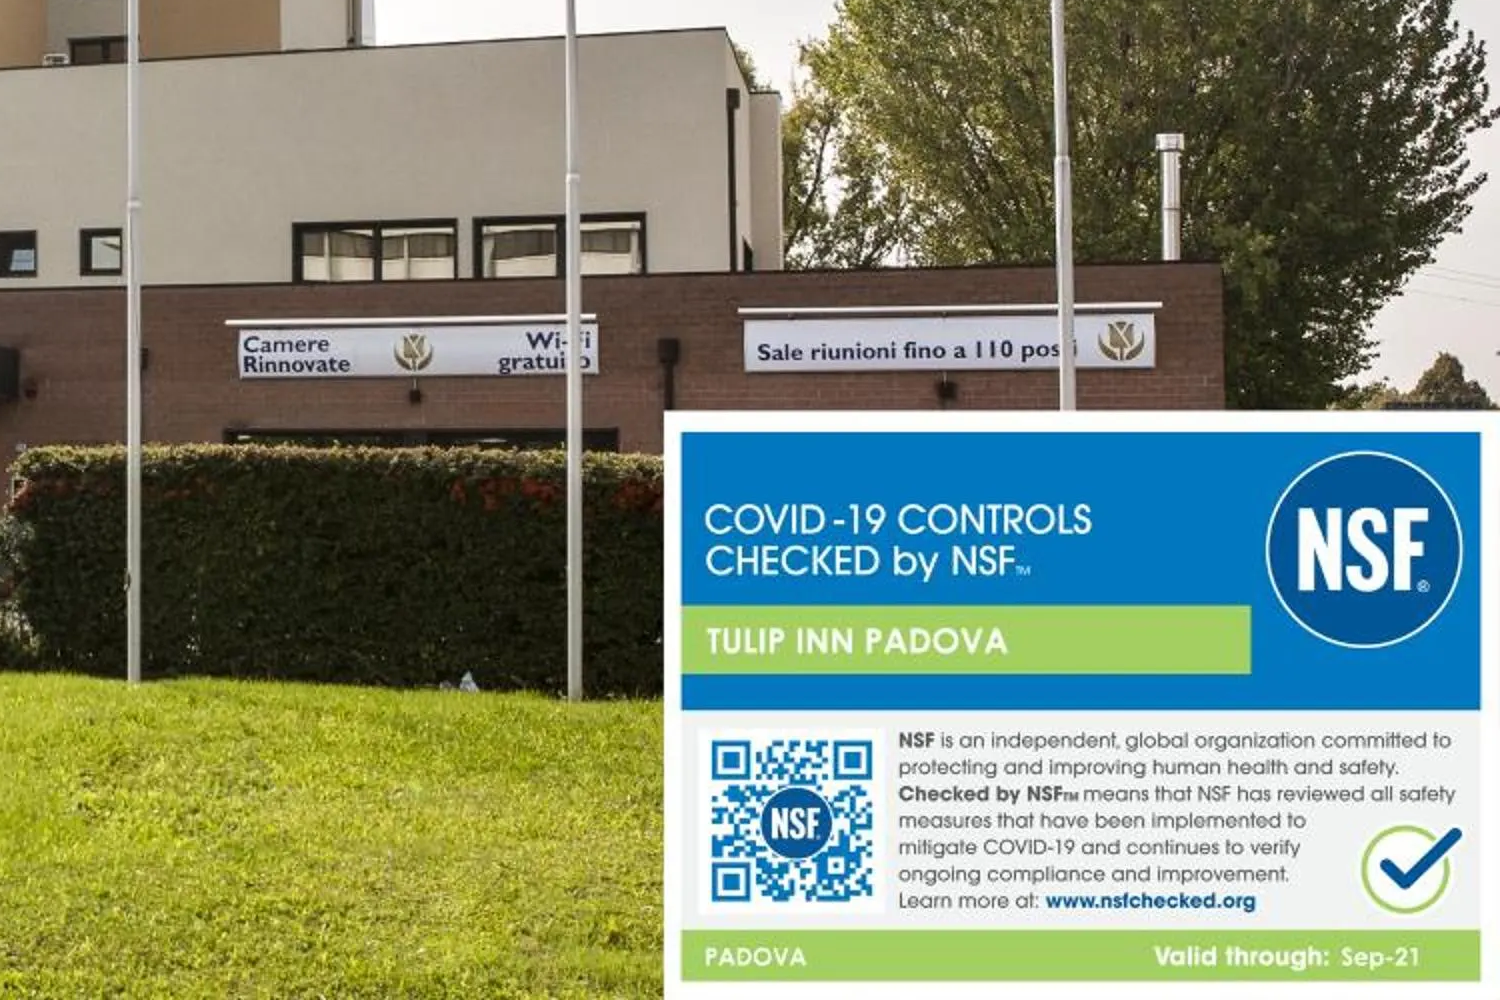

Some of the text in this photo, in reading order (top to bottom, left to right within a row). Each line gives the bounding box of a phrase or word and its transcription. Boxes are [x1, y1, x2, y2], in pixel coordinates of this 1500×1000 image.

[243, 335, 330, 354] Camere
[525, 331, 590, 350] Wi-i
[757, 339, 1078, 363] Sale riunioni fino a 110 posi
[243, 356, 351, 374] Rinnovate
[498, 351, 591, 375] gratuio
